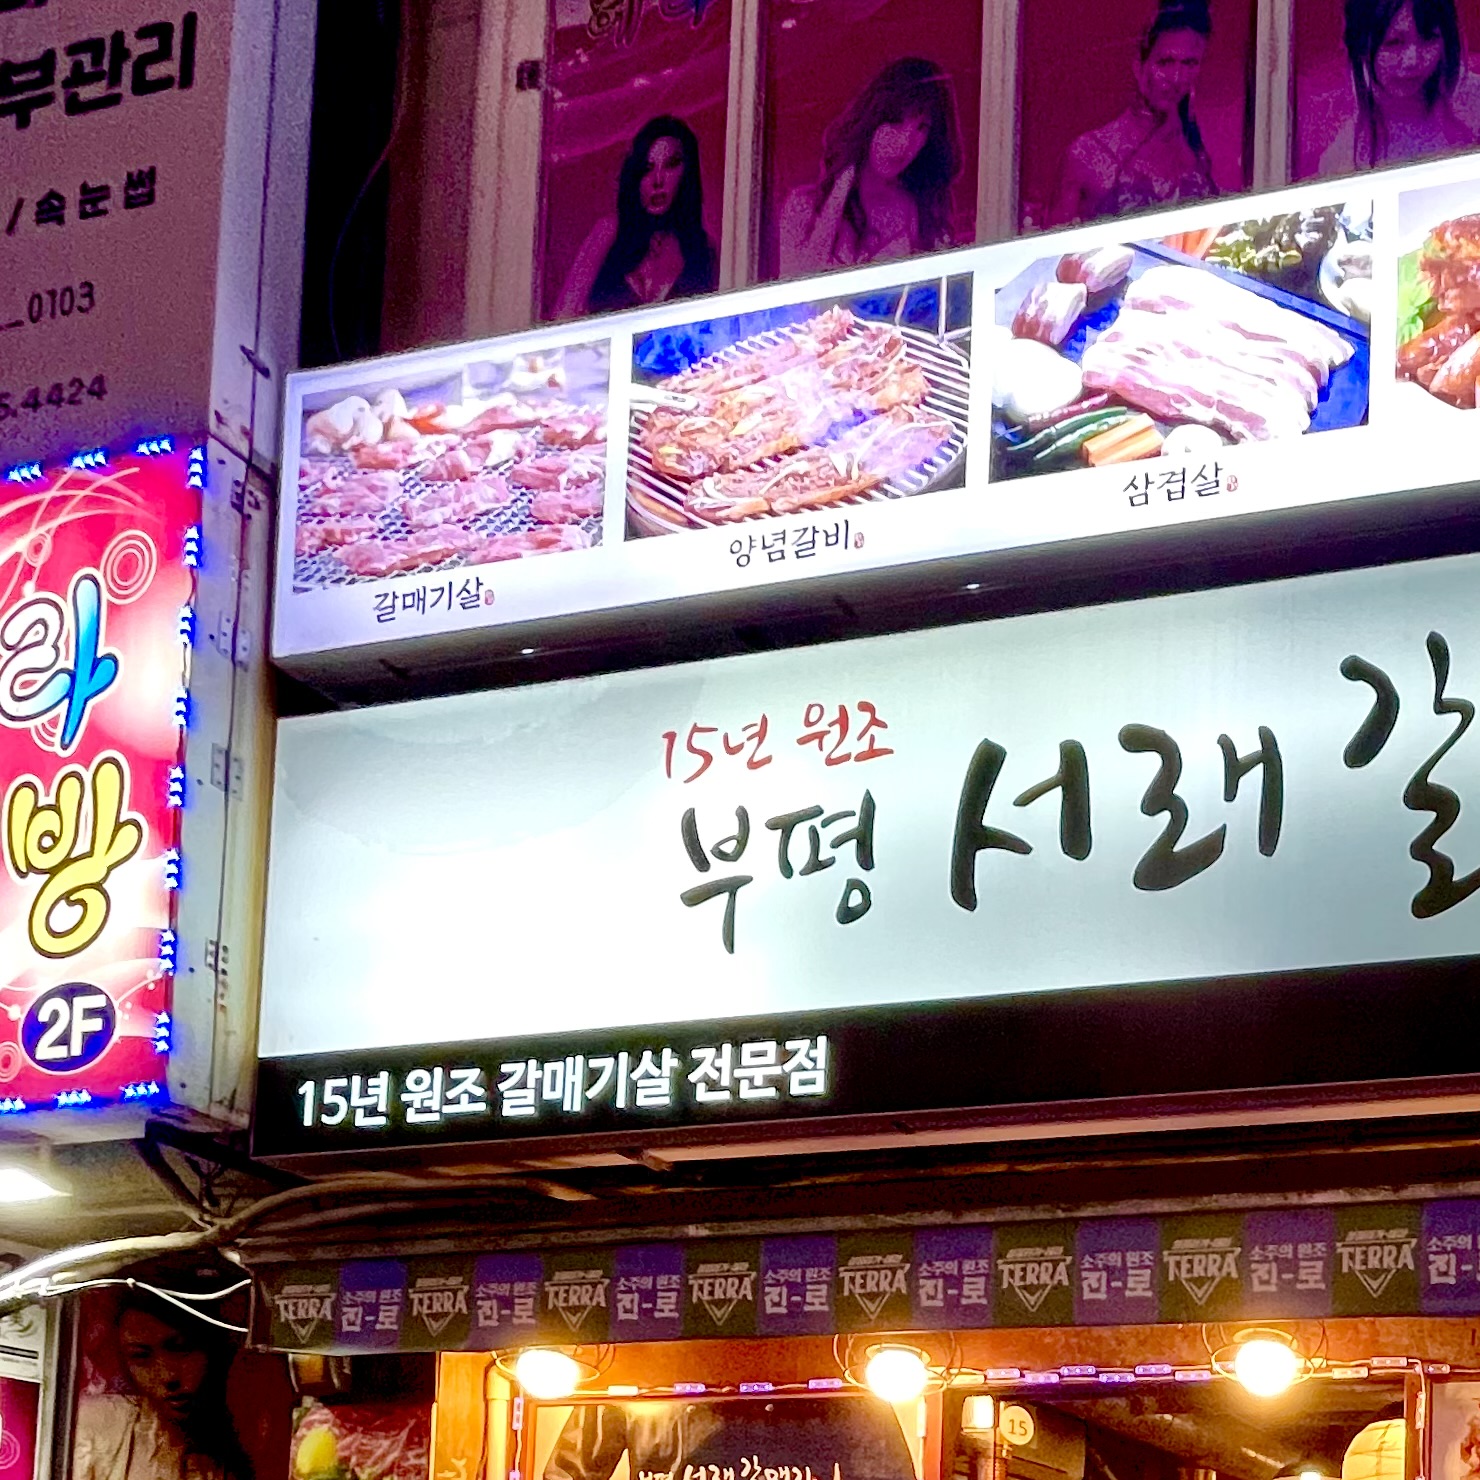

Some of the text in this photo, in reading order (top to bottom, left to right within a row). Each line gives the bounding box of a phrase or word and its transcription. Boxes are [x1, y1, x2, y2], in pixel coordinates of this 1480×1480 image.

[1123, 461, 1224, 508] 삼겹살
[728, 519, 853, 569] 양념갈비
[372, 577, 485, 623] 갈매기살
[661, 701, 894, 783] 15년 원조
[680, 789, 876, 954] 부평
[35, 991, 107, 1063] 2F
[297, 1034, 830, 1128] 15년 원조 갈매기살 전문점
[1165, 1248, 1240, 1281] TERRA
[1339, 1242, 1415, 1274] TERRA
[691, 1275, 754, 1303] TERRA
[841, 1267, 908, 1297] TERRA
[1001, 1260, 1070, 1290] TERRA
[278, 1297, 334, 1322] TERRA
[411, 1290, 468, 1317] TERRA
[547, 1283, 607, 1308] TERRA
[1007, 1418, 1029, 1436] 15
